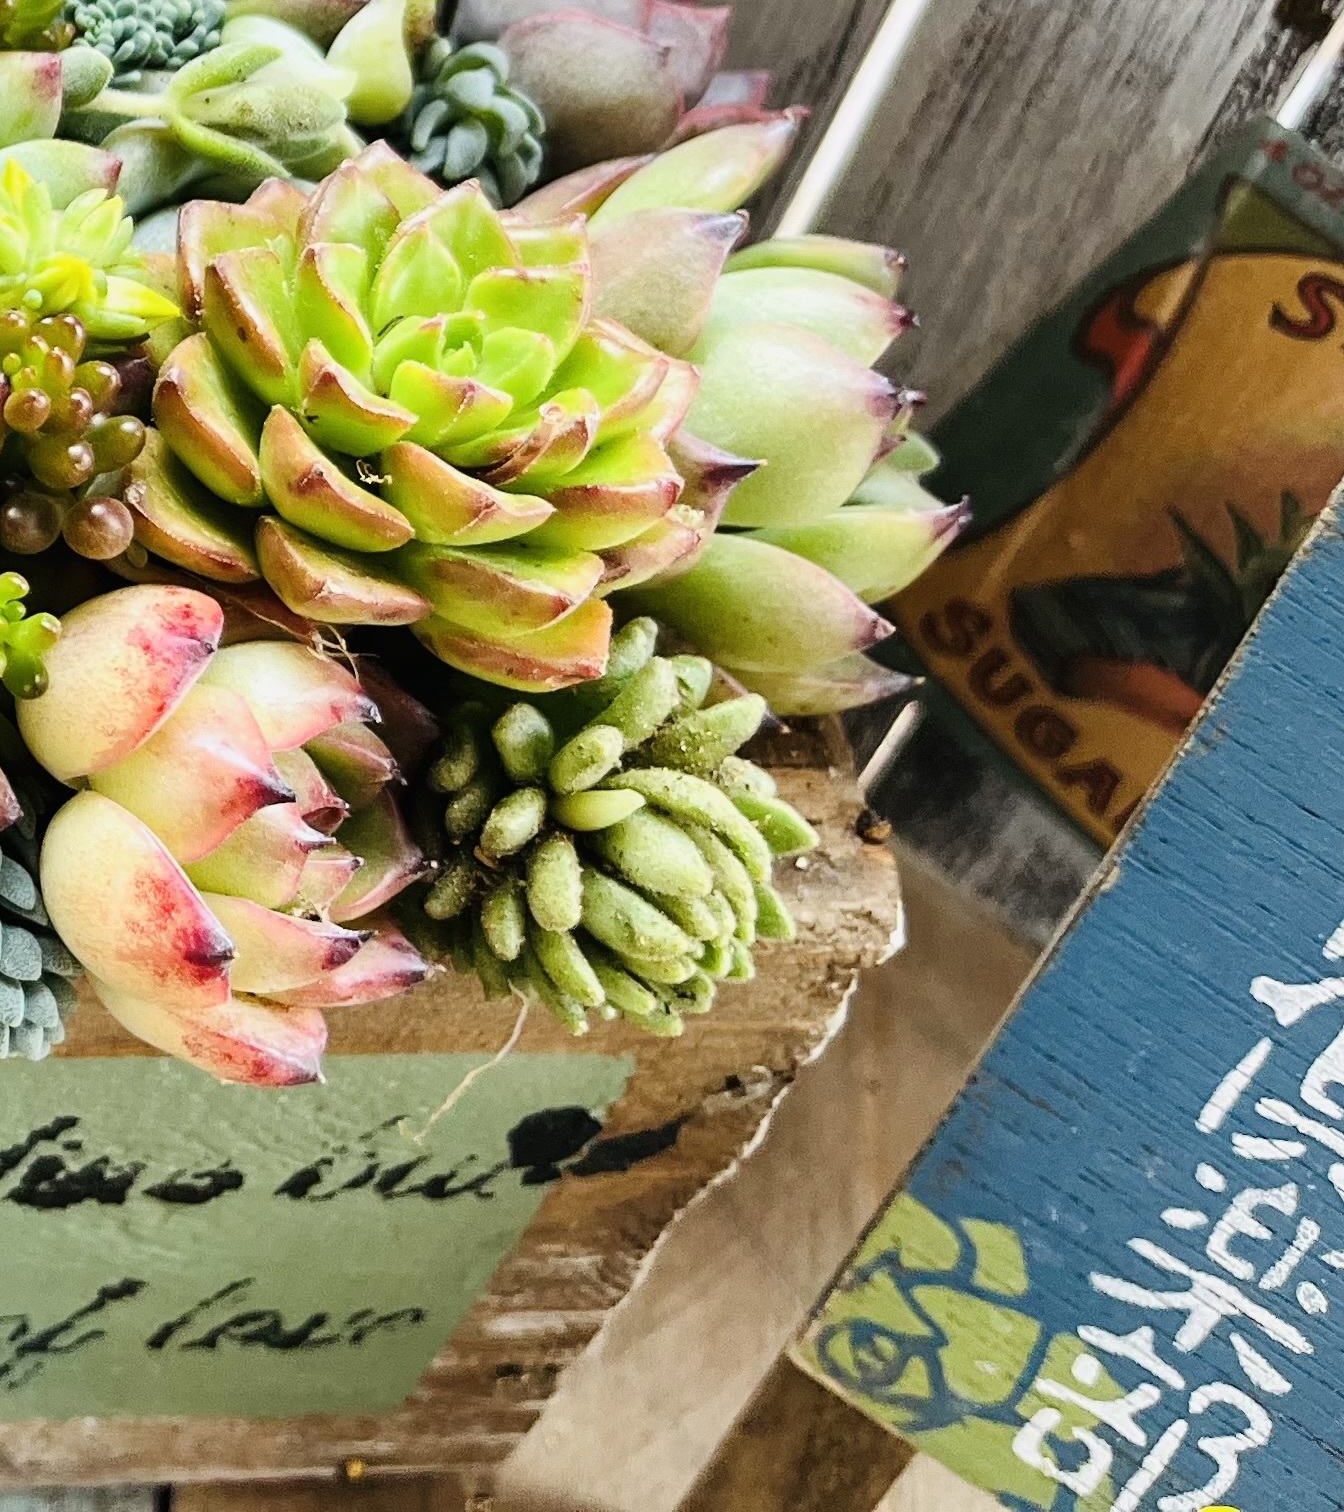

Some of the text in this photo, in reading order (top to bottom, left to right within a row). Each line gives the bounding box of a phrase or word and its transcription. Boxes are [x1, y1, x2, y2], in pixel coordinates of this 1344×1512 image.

[918, 596, 1144, 833] SUGA
[1012, 920, 1344, 1512] 俱樂部
